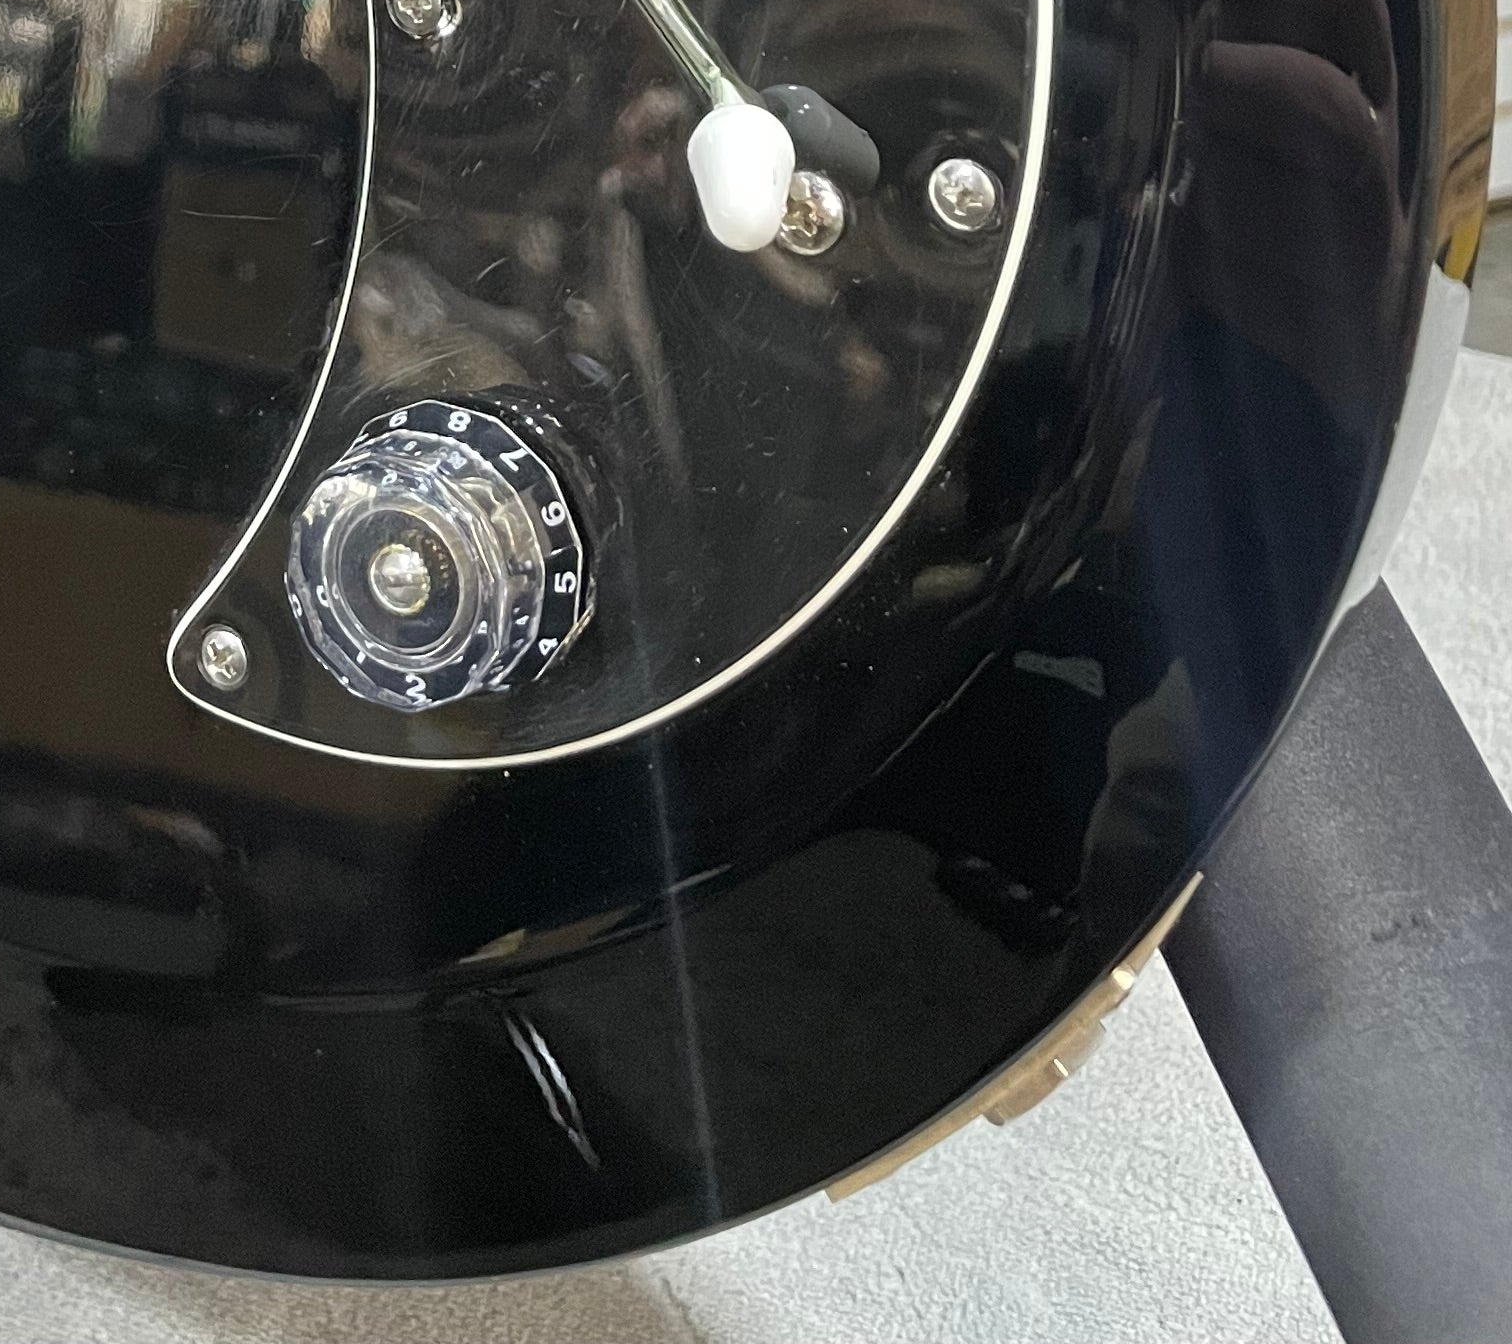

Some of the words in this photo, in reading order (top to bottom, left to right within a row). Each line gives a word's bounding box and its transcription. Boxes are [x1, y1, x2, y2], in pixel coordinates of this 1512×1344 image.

[447, 411, 472, 433] 8
[498, 447, 530, 472] 7
[541, 501, 566, 527] 6
[554, 571, 577, 594] 5
[538, 637, 559, 656] 4
[405, 673, 429, 704] 2
